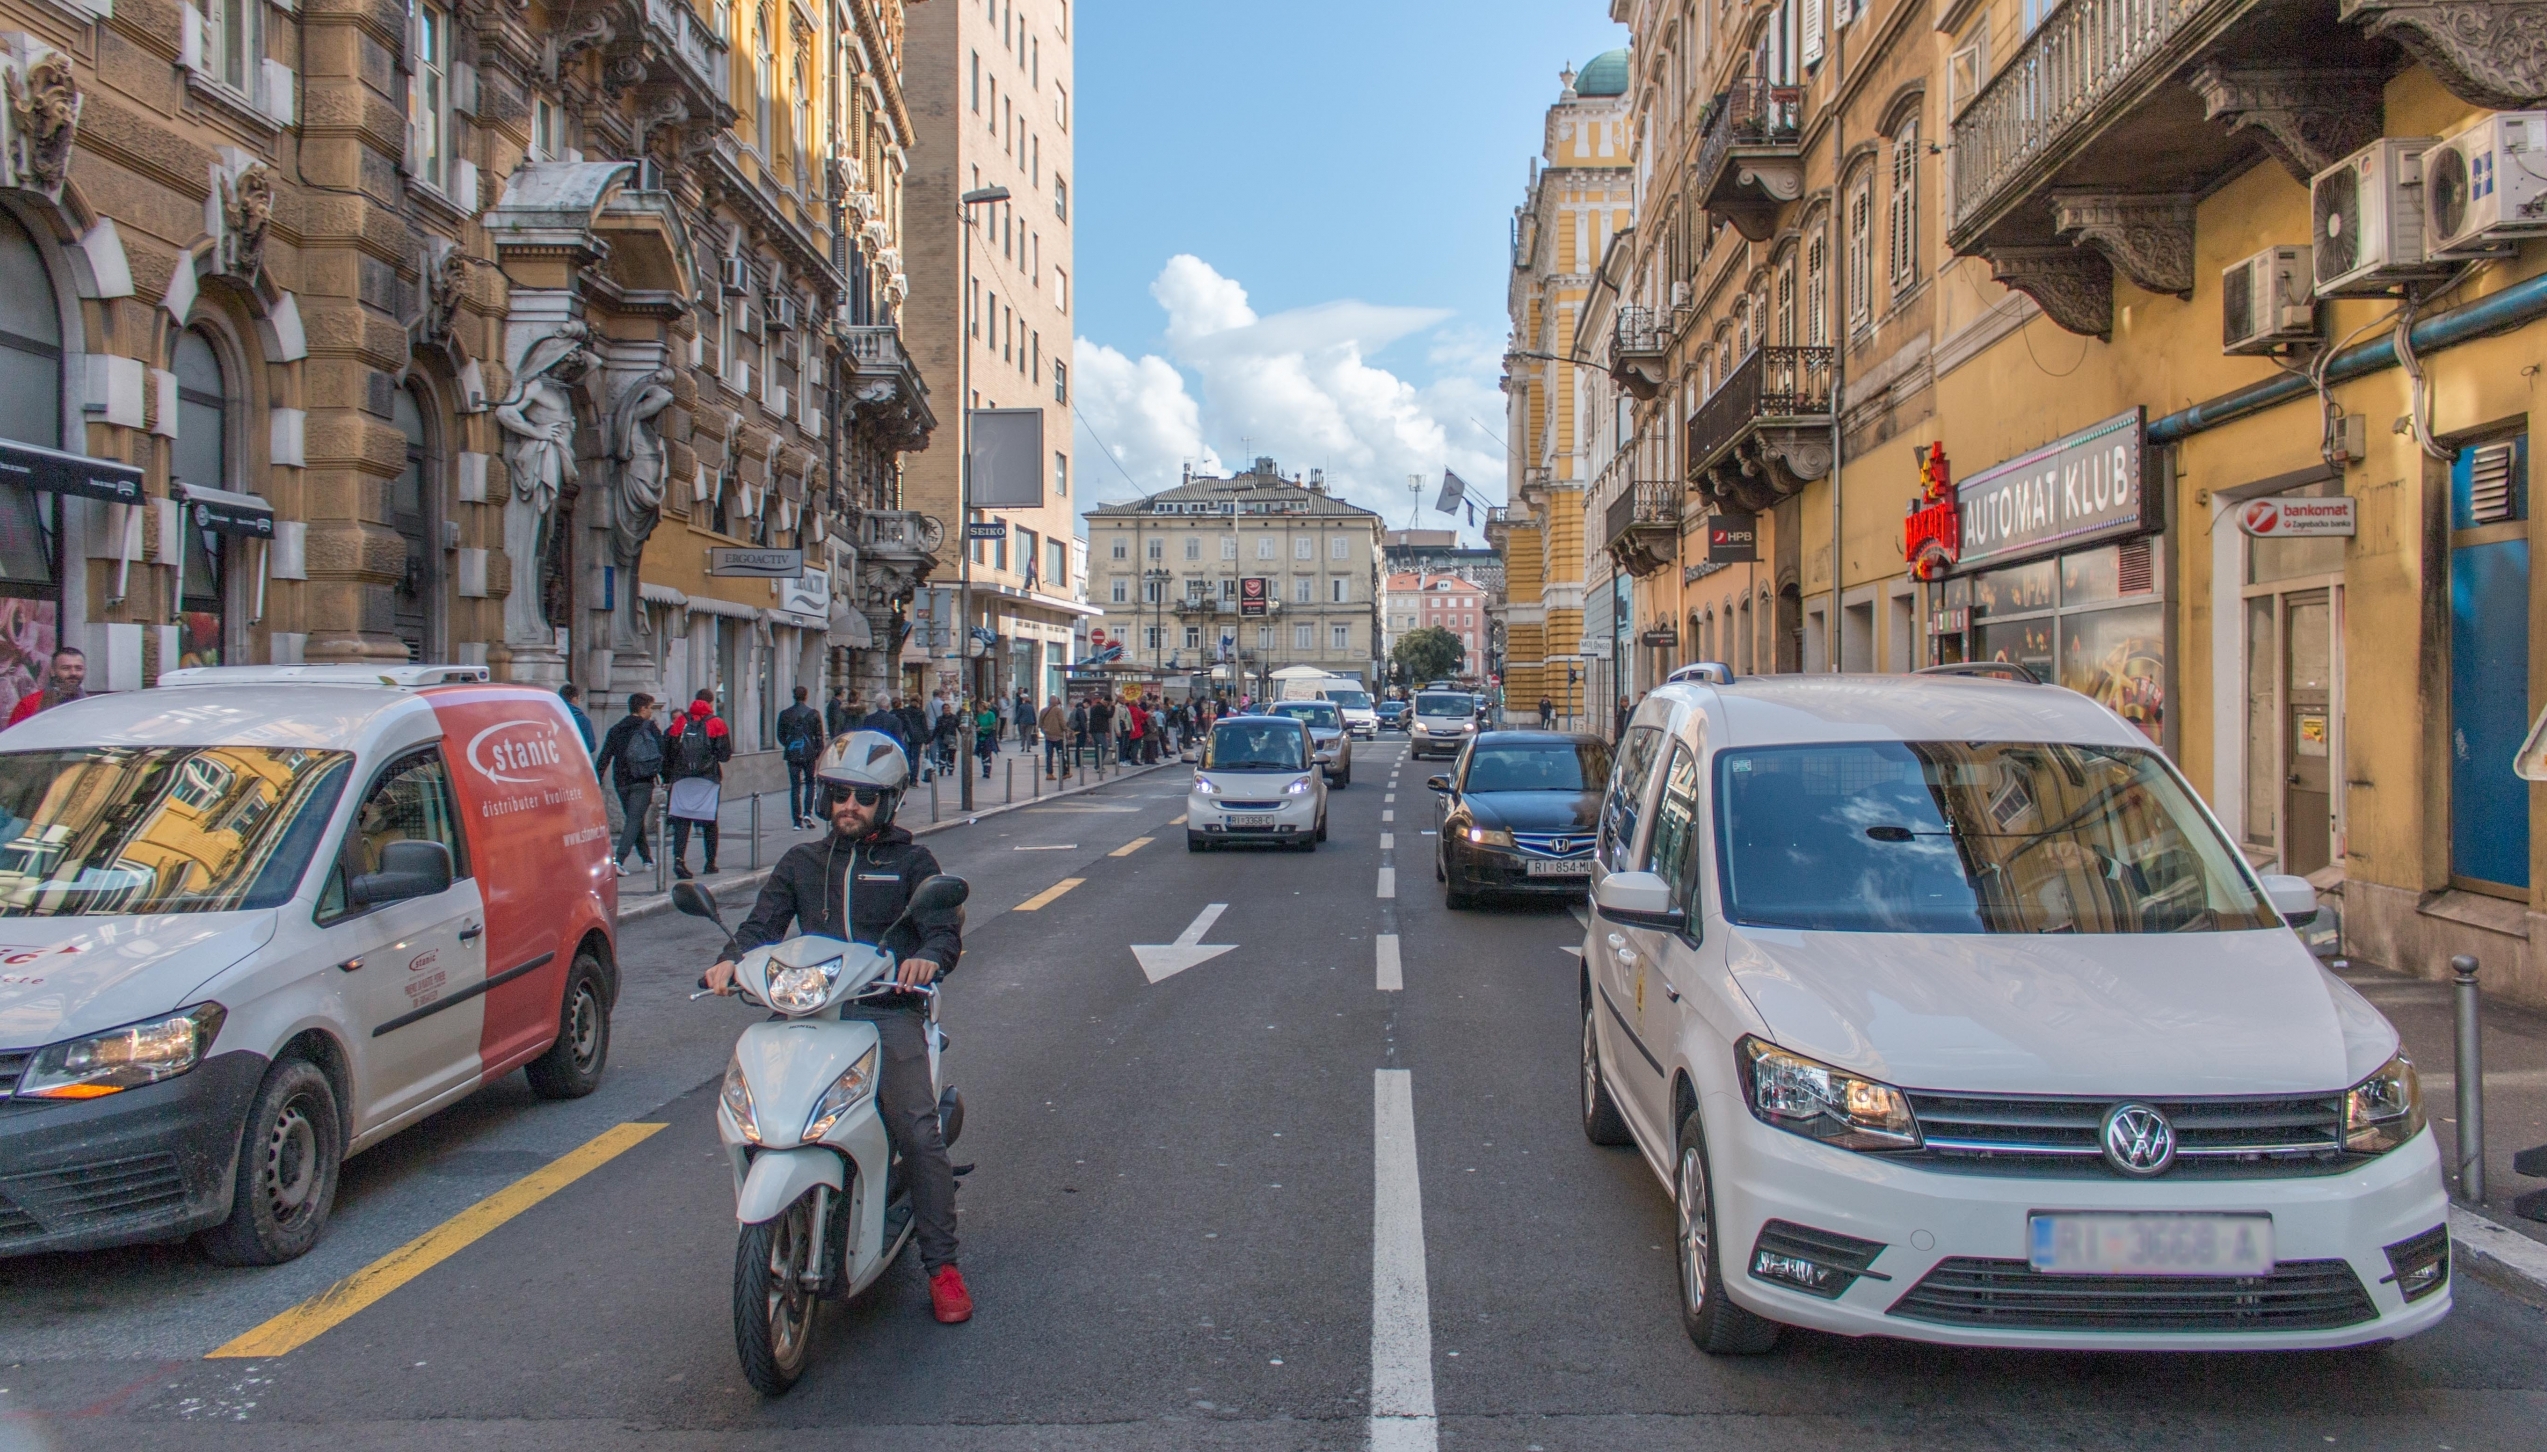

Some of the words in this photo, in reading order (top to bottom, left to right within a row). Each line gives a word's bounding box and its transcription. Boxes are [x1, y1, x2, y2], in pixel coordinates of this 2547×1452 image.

[1965, 470, 2057, 548] AUTOMAT
[2065, 445, 2129, 519] KLUB
[2284, 504, 2348, 516] bankomat
[2330, 520, 2351, 528] banka
[970, 527, 1005, 536] SEIKO
[1727, 531, 1752, 542] HPB
[725, 553, 789, 564] ERGOACTIV
[493, 729, 560, 772] stanić
[482, 796, 539, 818] distributer
[543, 787, 583, 806] kvalitete
[1534, 862, 1547, 873] RI
[1555, 861, 1593, 873] 854-MU
